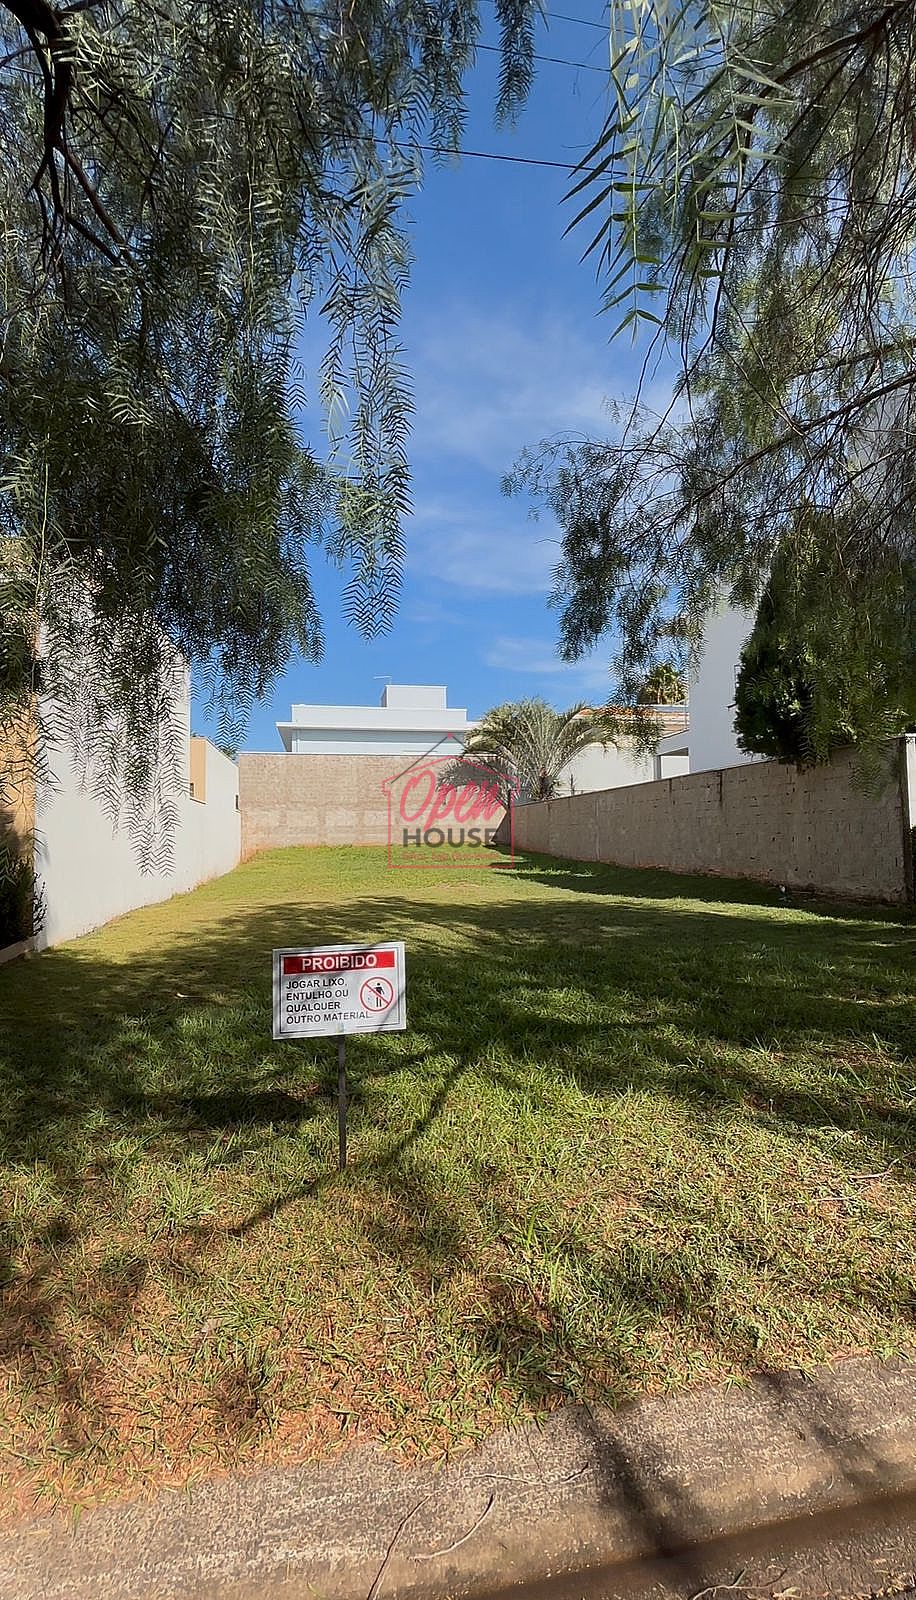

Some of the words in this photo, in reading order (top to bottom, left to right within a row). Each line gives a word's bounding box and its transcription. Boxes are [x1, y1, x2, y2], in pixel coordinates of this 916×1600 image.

[302, 954, 377, 971] PROIBIDO
[286, 979, 320, 989] JOGAR
[286, 990, 332, 1001] ENTULHO
[334, 989, 349, 998] OU
[286, 1001, 341, 1013] QUALQUER
[286, 1014, 321, 1024] OUTRO
